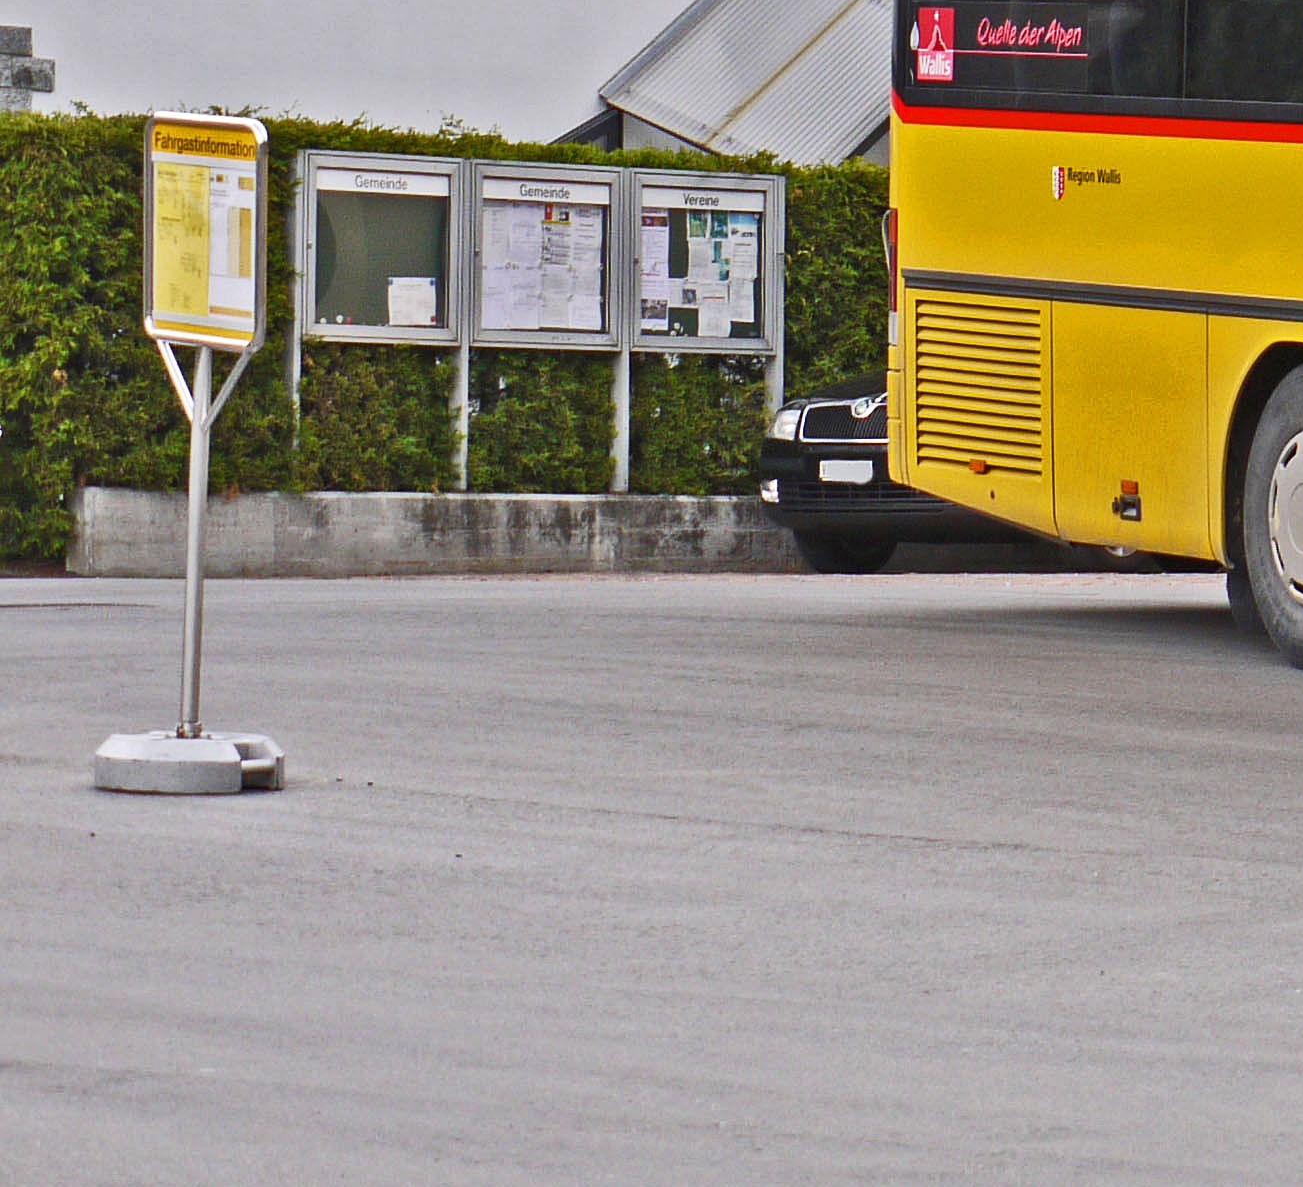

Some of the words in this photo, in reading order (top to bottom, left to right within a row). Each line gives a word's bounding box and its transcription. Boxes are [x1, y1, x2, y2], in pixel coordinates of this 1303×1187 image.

[977, 16, 1017, 47] Quelle
[1018, 19, 1045, 48] der
[1044, 17, 1083, 53] Alpen
[918, 54, 952, 76] Wallis
[154, 131, 256, 158] Fahrgastinformation
[354, 174, 409, 191] Gemeinde
[1067, 167, 1095, 186] Region
[1096, 168, 1121, 184] Wallis
[519, 183, 571, 200] Gemeinde
[683, 193, 720, 207] Vereine
